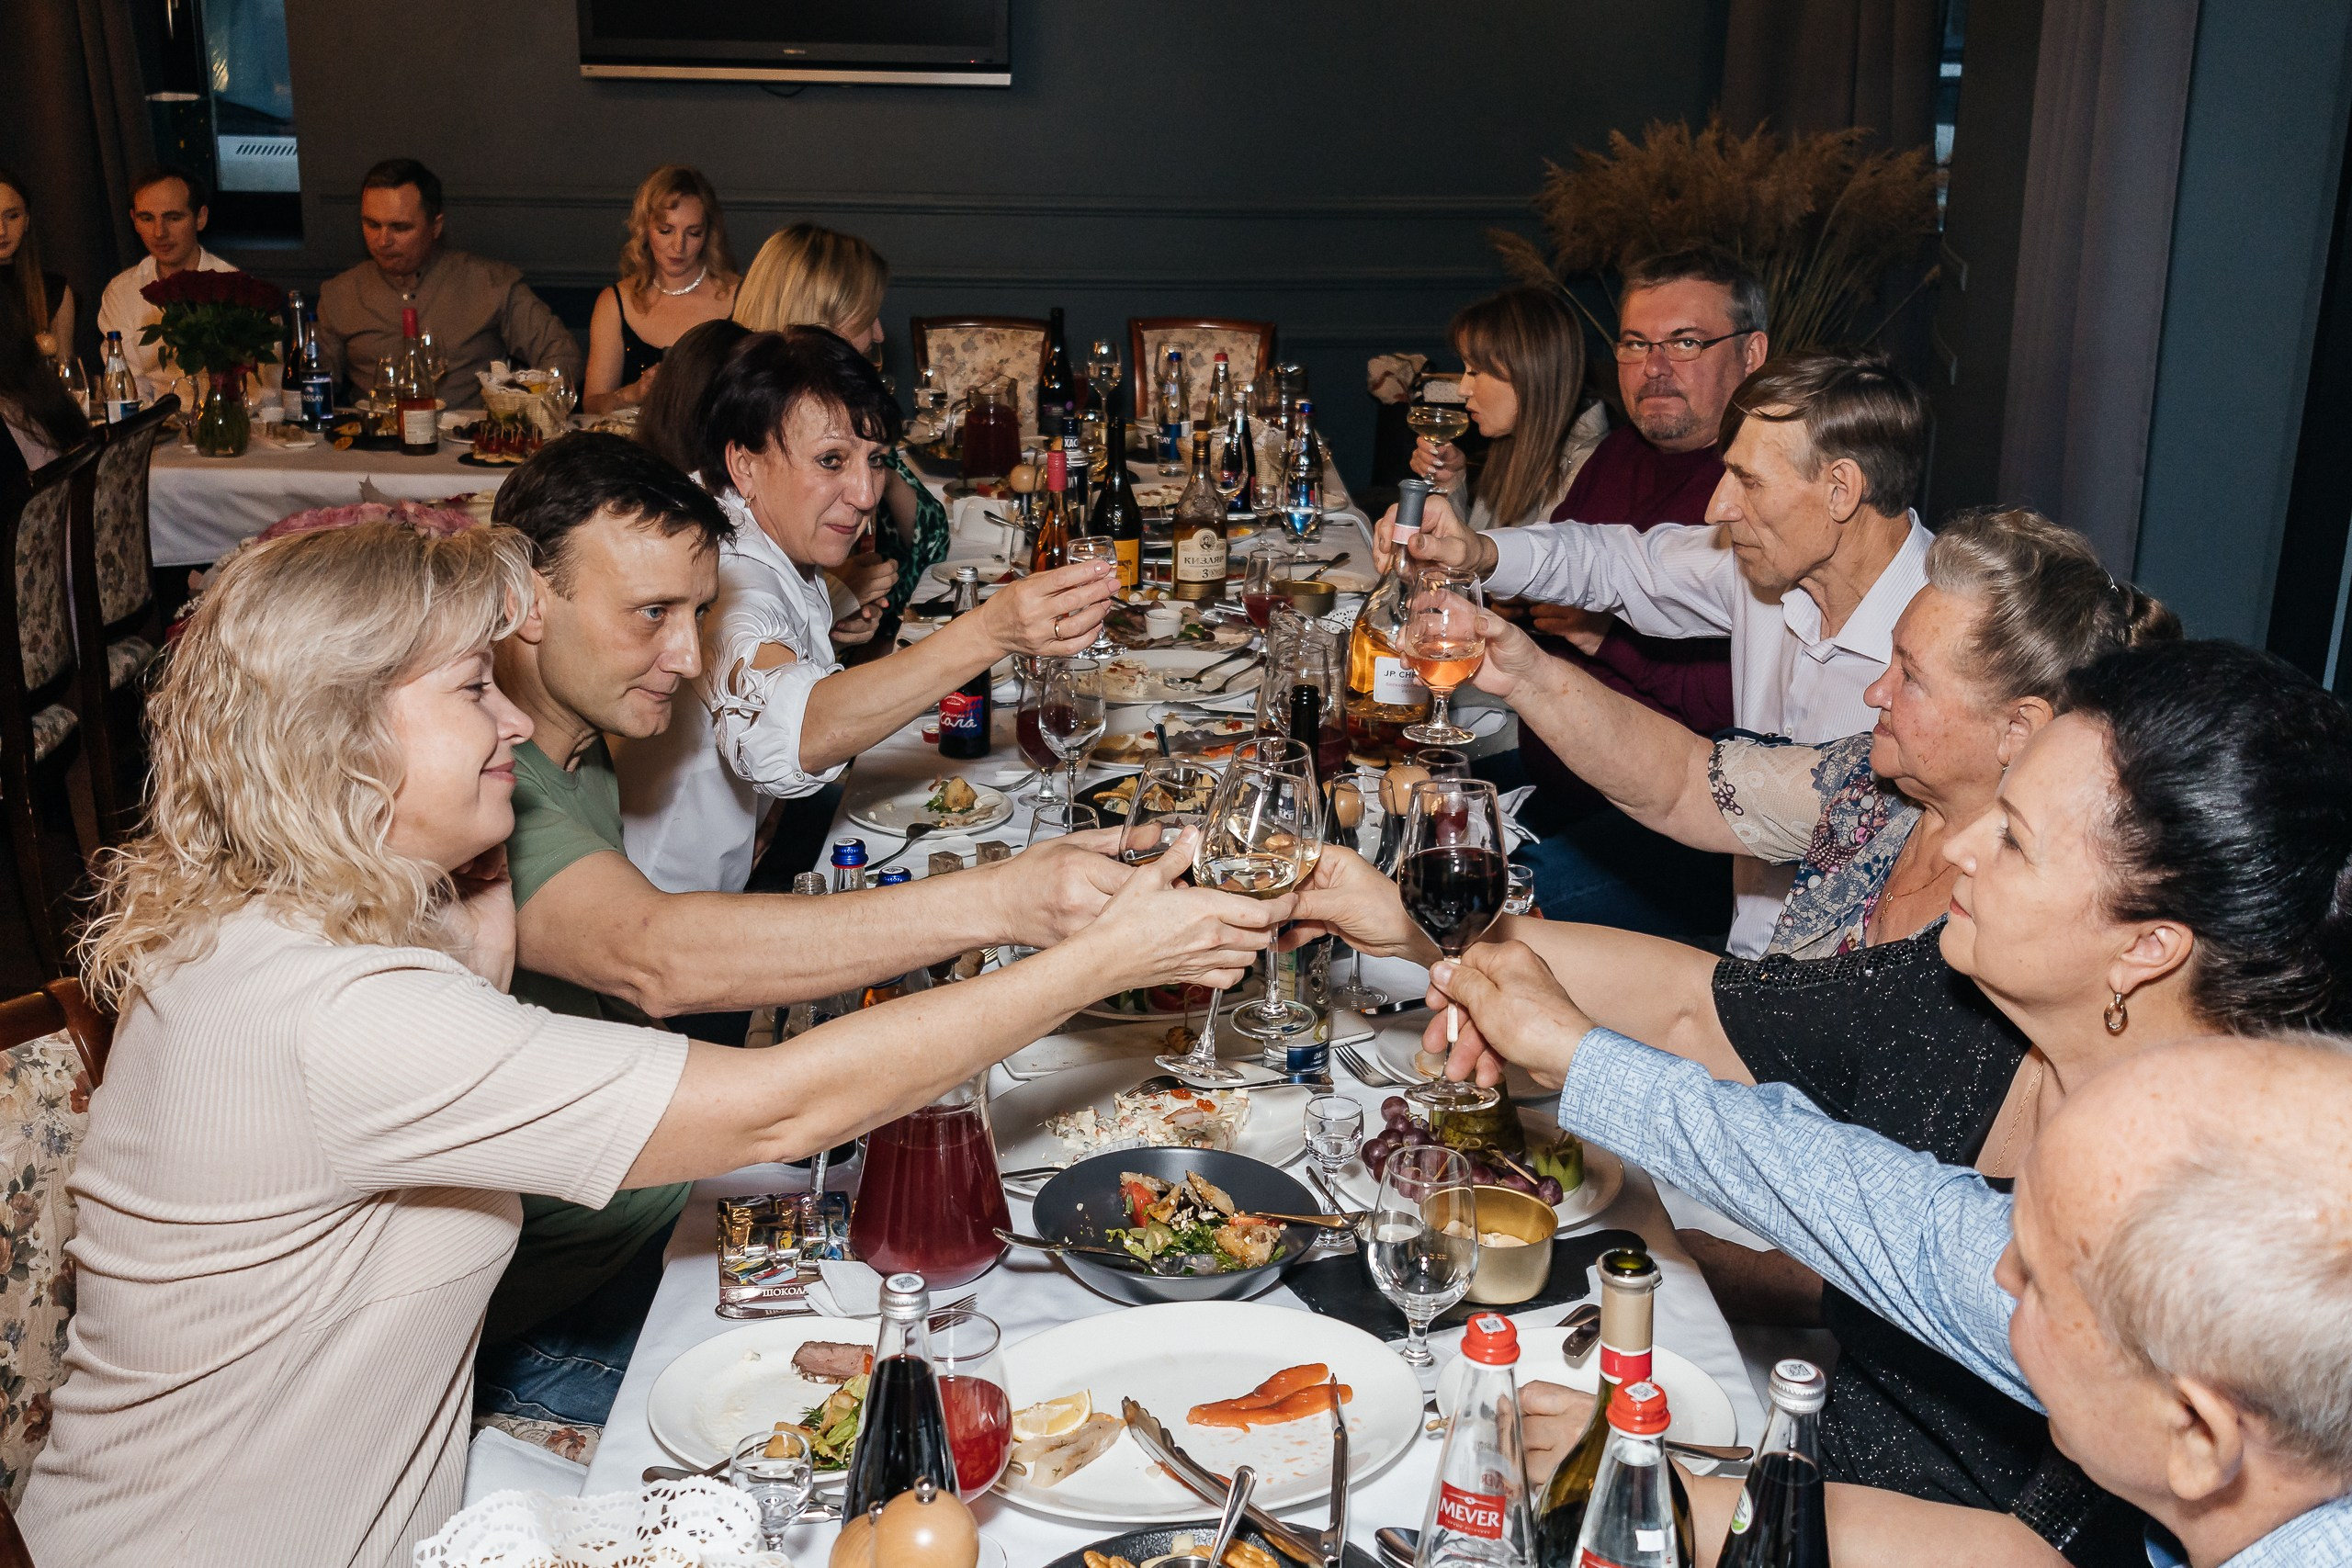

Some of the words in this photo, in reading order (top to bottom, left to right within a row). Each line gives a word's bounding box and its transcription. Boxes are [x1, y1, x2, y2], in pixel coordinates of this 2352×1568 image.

[1183, 555, 1225, 565] КИЗЛЯР
[1202, 569, 1209, 579] 3
[1439, 1496, 1500, 1529] MEVER
